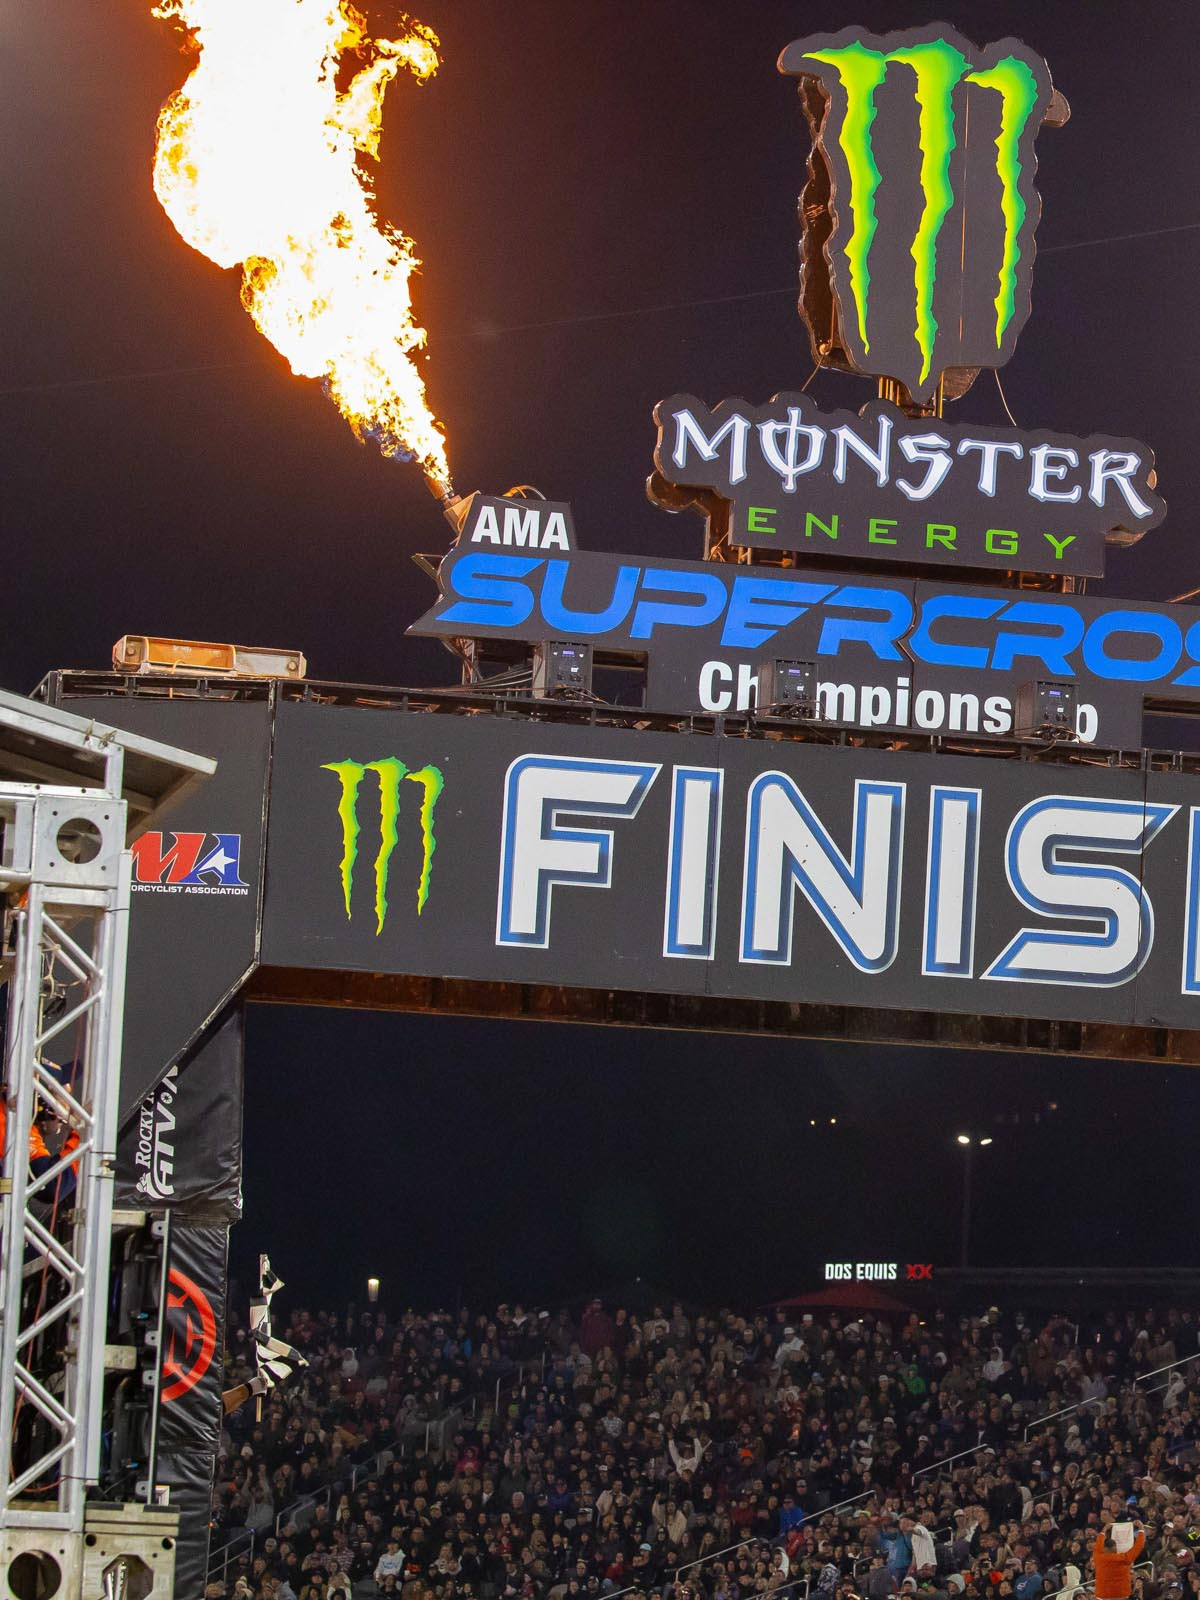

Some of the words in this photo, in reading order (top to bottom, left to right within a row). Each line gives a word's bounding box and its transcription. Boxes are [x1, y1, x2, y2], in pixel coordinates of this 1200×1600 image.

[672, 406, 1153, 519] MONSTER
[471, 506, 570, 551] AMA
[747, 507, 1077, 559] ENERGY
[699, 660, 1099, 743] Chmpionsp
[131, 831, 250, 886] MA
[131, 884, 183, 894] ORCYCLIST
[185, 886, 248, 896] ASSOCIATION
[136, 1105, 154, 1170] ROCKY
[825, 1263, 852, 1280] DOS
[856, 1263, 897, 1281] EQUIS
